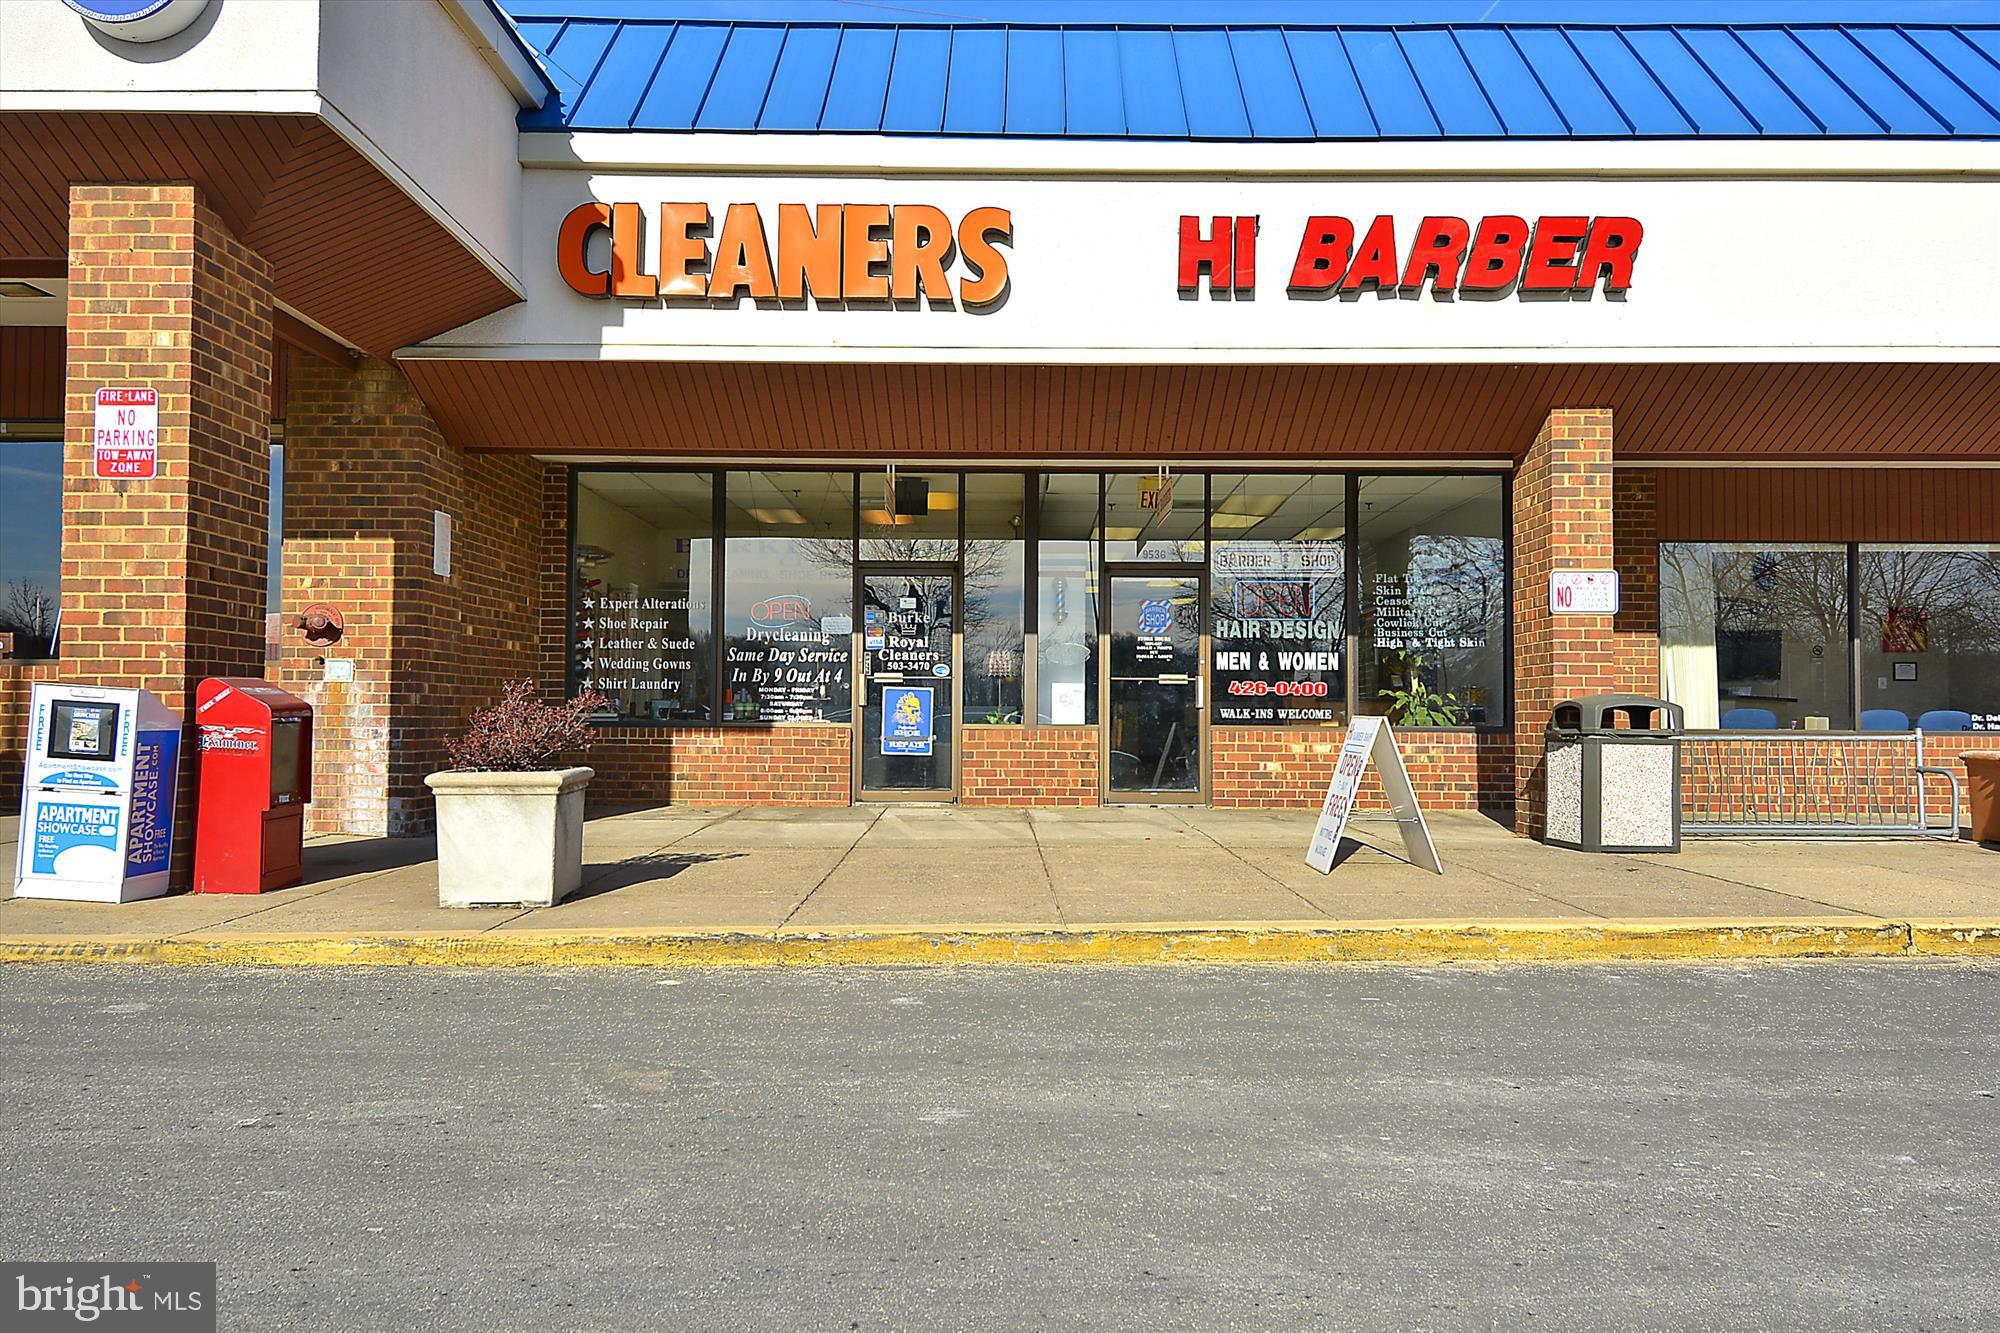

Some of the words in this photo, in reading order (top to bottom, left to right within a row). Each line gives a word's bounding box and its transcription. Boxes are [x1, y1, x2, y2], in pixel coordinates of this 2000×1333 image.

[557, 202, 1012, 307] CLEANERS
[1178, 215, 1256, 301] HI
[1286, 215, 1643, 302] BARBER
[100, 391, 123, 401] FIRE
[129, 391, 154, 401] LANE
[118, 409, 135, 426] NO
[98, 429, 155, 446] PARKING
[98, 450, 153, 460] TOW-AWAY
[110, 462, 141, 473] ZONE
[1141, 491, 1159, 509] EXI
[1142, 549, 1167, 559] 9536
[1219, 554, 1272, 567] BARBER
[1301, 554, 1335, 567] SHOP
[600, 597, 639, 612] Expert
[642, 598, 706, 610] Alterations
[1239, 583, 1313, 617] OPEN
[1557, 586, 1572, 608] NO
[751, 602, 812, 621] OPEN
[888, 612, 930, 623] Burke
[599, 617, 627, 629] Shoe
[630, 617, 669, 632] Repair
[1146, 614, 1165, 625] SHOP
[746, 627, 831, 645] Drycleaning
[1216, 620, 1261, 638] HAIR
[1270, 620, 1340, 639] DESIGN
[1428, 628, 1448, 637] Cut
[599, 638, 644, 649] Leather
[647, 638, 658, 649] &
[662, 638, 696, 649] Suede
[888, 636, 929, 650] Royal
[1411, 639, 1421, 648] &
[1425, 638, 1456, 649] Tight
[1460, 638, 1486, 648] Skin
[727, 647, 764, 662] Same
[768, 647, 796, 665] Day
[798, 647, 849, 663] Service
[878, 649, 939, 661] Cleaners
[1216, 652, 1251, 670] MEN
[1258, 651, 1270, 671] &
[1278, 652, 1339, 671] WOMEN
[598, 657, 649, 672] Wedding
[653, 657, 692, 670] Gowns
[887, 661, 930, 671] 503-3470
[732, 668, 747, 682] In
[752, 668, 770, 685] By
[774, 668, 783, 682] 9
[785, 668, 812, 683] Out
[813, 668, 831, 683] At
[834, 668, 844, 683] 4
[598, 678, 627, 689] Shirt
[631, 678, 681, 692] Laundry
[1228, 681, 1328, 696] 426-0400
[1220, 708, 1273, 719] WALK-INS
[1277, 708, 1332, 719] WELCOME
[36, 704, 45, 750] FREE
[121, 710, 130, 756] FREE
[1972, 722, 1986, 730] Dr.
[128, 742, 151, 864] APARTMENT
[38, 805, 119, 825] APARTMENT
[37, 821, 99, 836] SHOWCASE
[39, 835, 56, 843] FREE
